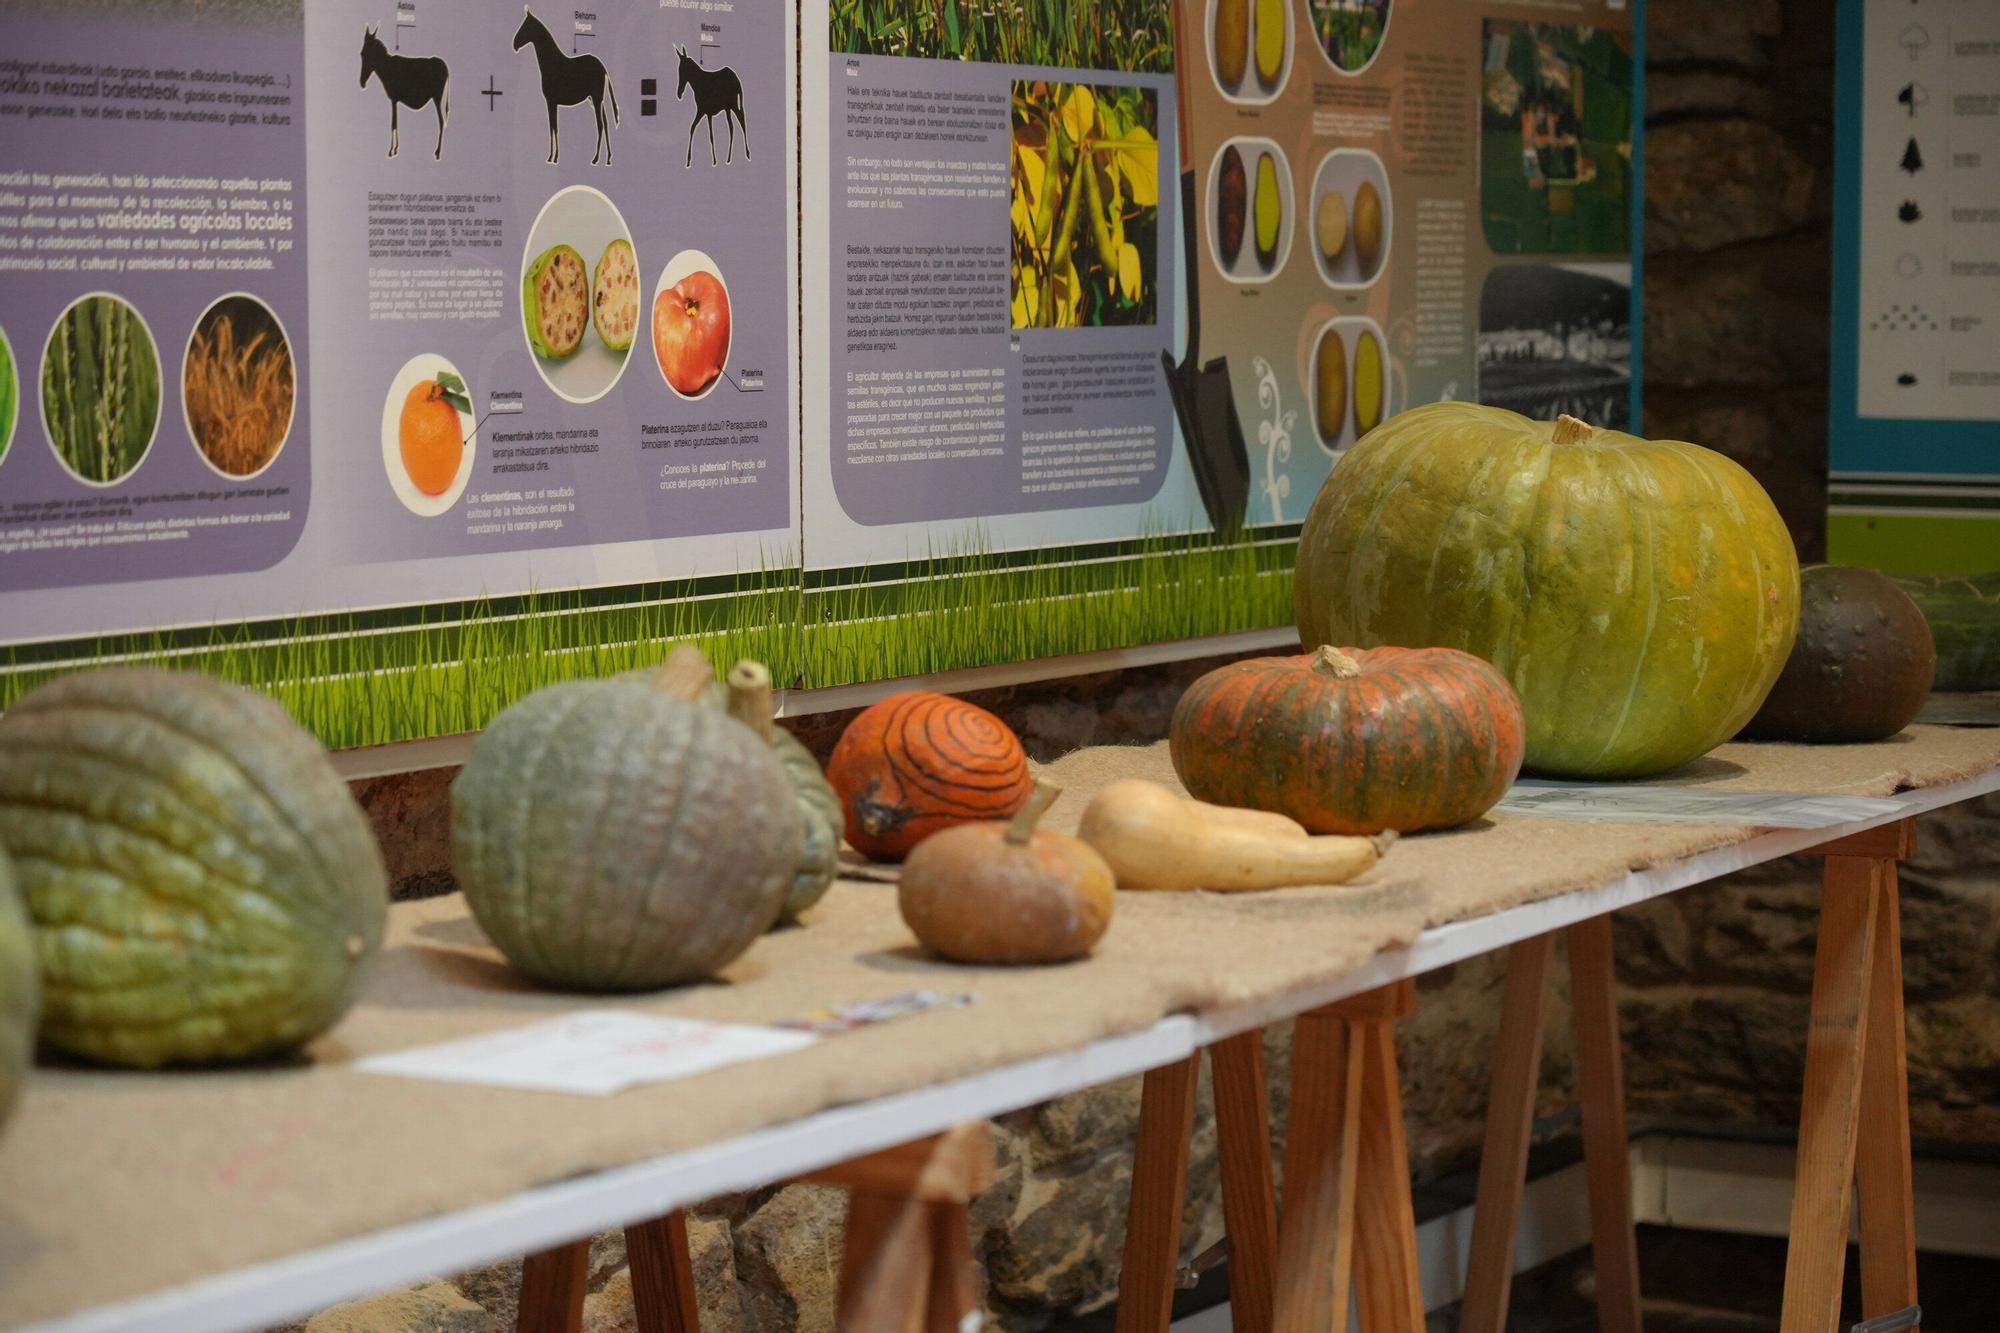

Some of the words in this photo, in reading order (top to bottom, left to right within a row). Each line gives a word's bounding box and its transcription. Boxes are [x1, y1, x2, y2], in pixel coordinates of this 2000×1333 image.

[97, 211, 175, 229] variedades
[179, 209, 241, 232] agrícolas
[244, 214, 292, 230] locales
